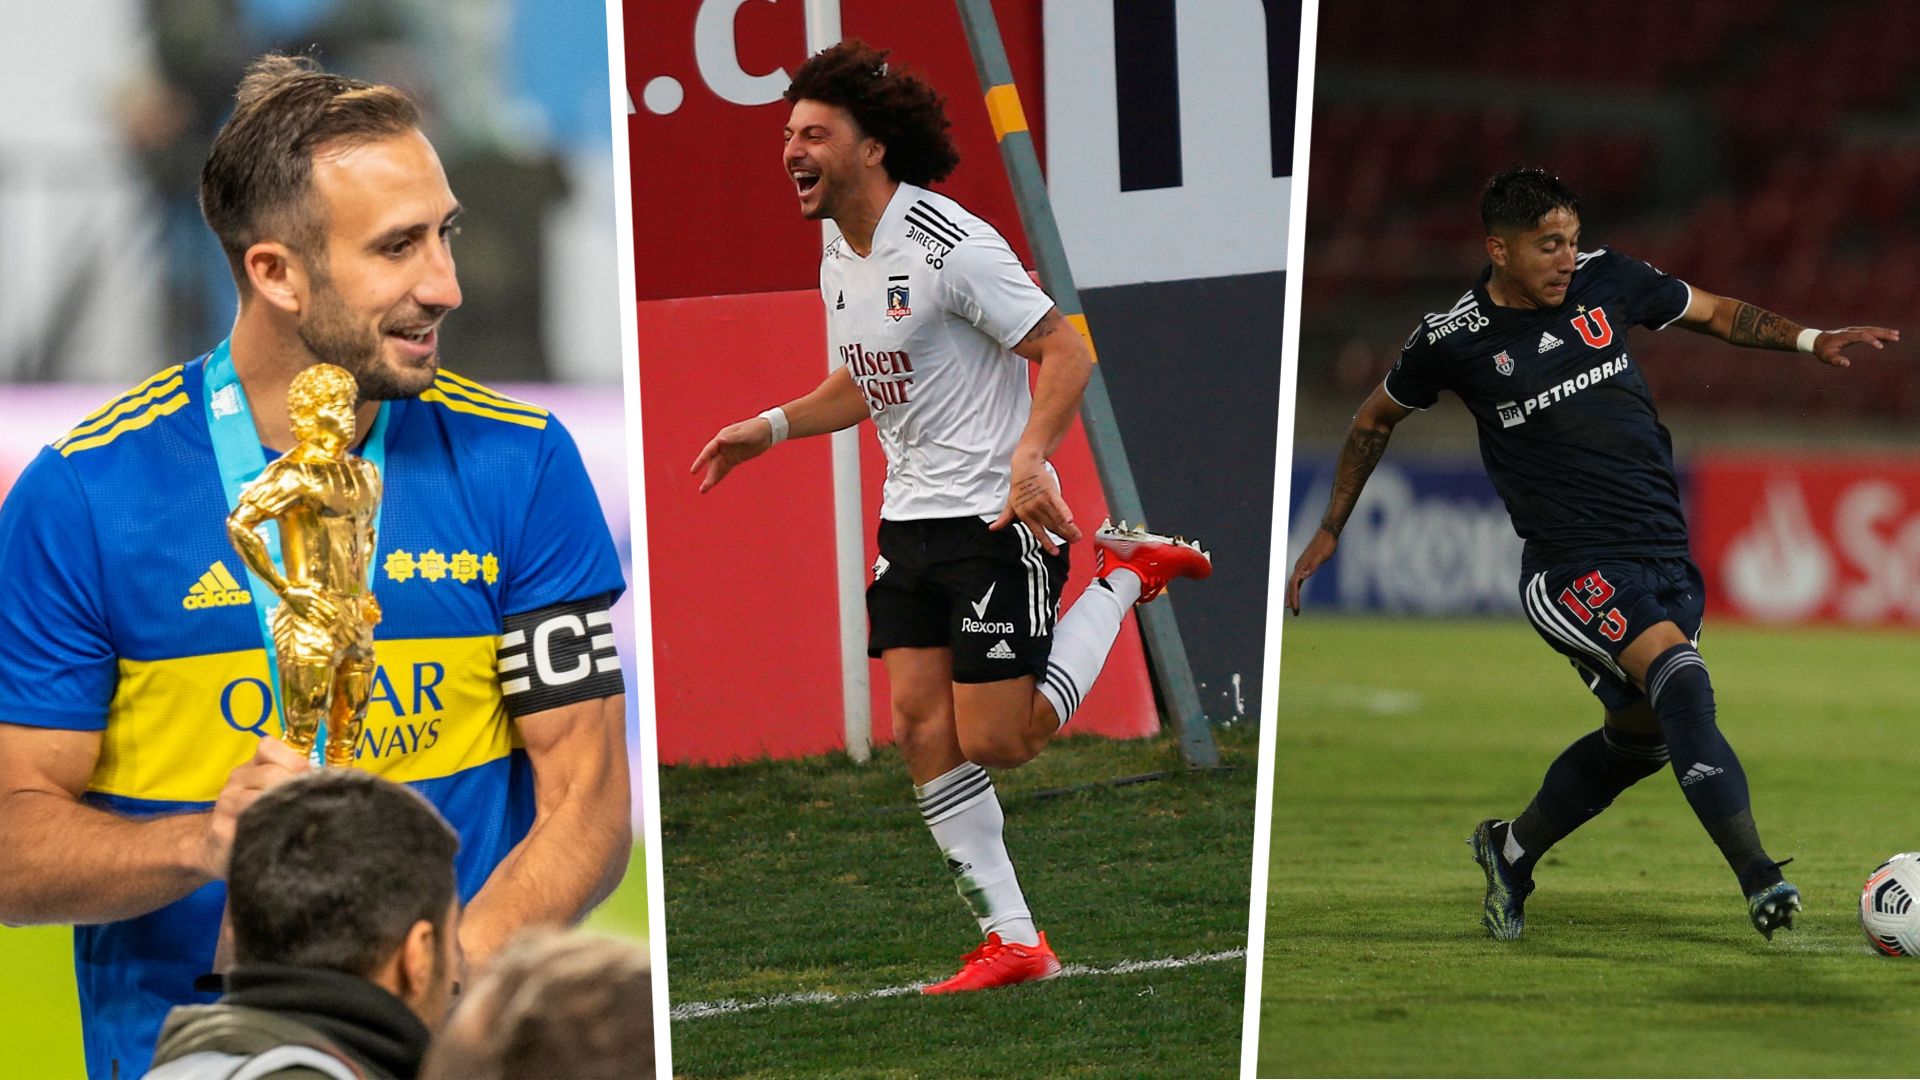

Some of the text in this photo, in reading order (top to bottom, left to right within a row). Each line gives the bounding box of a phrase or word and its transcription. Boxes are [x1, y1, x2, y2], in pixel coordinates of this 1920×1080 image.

[905, 225, 951, 258] DIRECTV
[925, 253, 944, 270] GO
[1426, 307, 1481, 346] DIRECTV
[1468, 316, 1490, 333] GO
[1570, 306, 1614, 349] U
[1537, 338, 1565, 354] adidas
[1502, 353, 1629, 421] BR PETROBRAS
[182, 588, 252, 610] adidas
[1557, 570, 1616, 626] 13
[961, 617, 1015, 634] Rexona
[533, 614, 592, 686] C
[986, 651, 1016, 659] adidas
[1681, 767, 1724, 787] adidas
